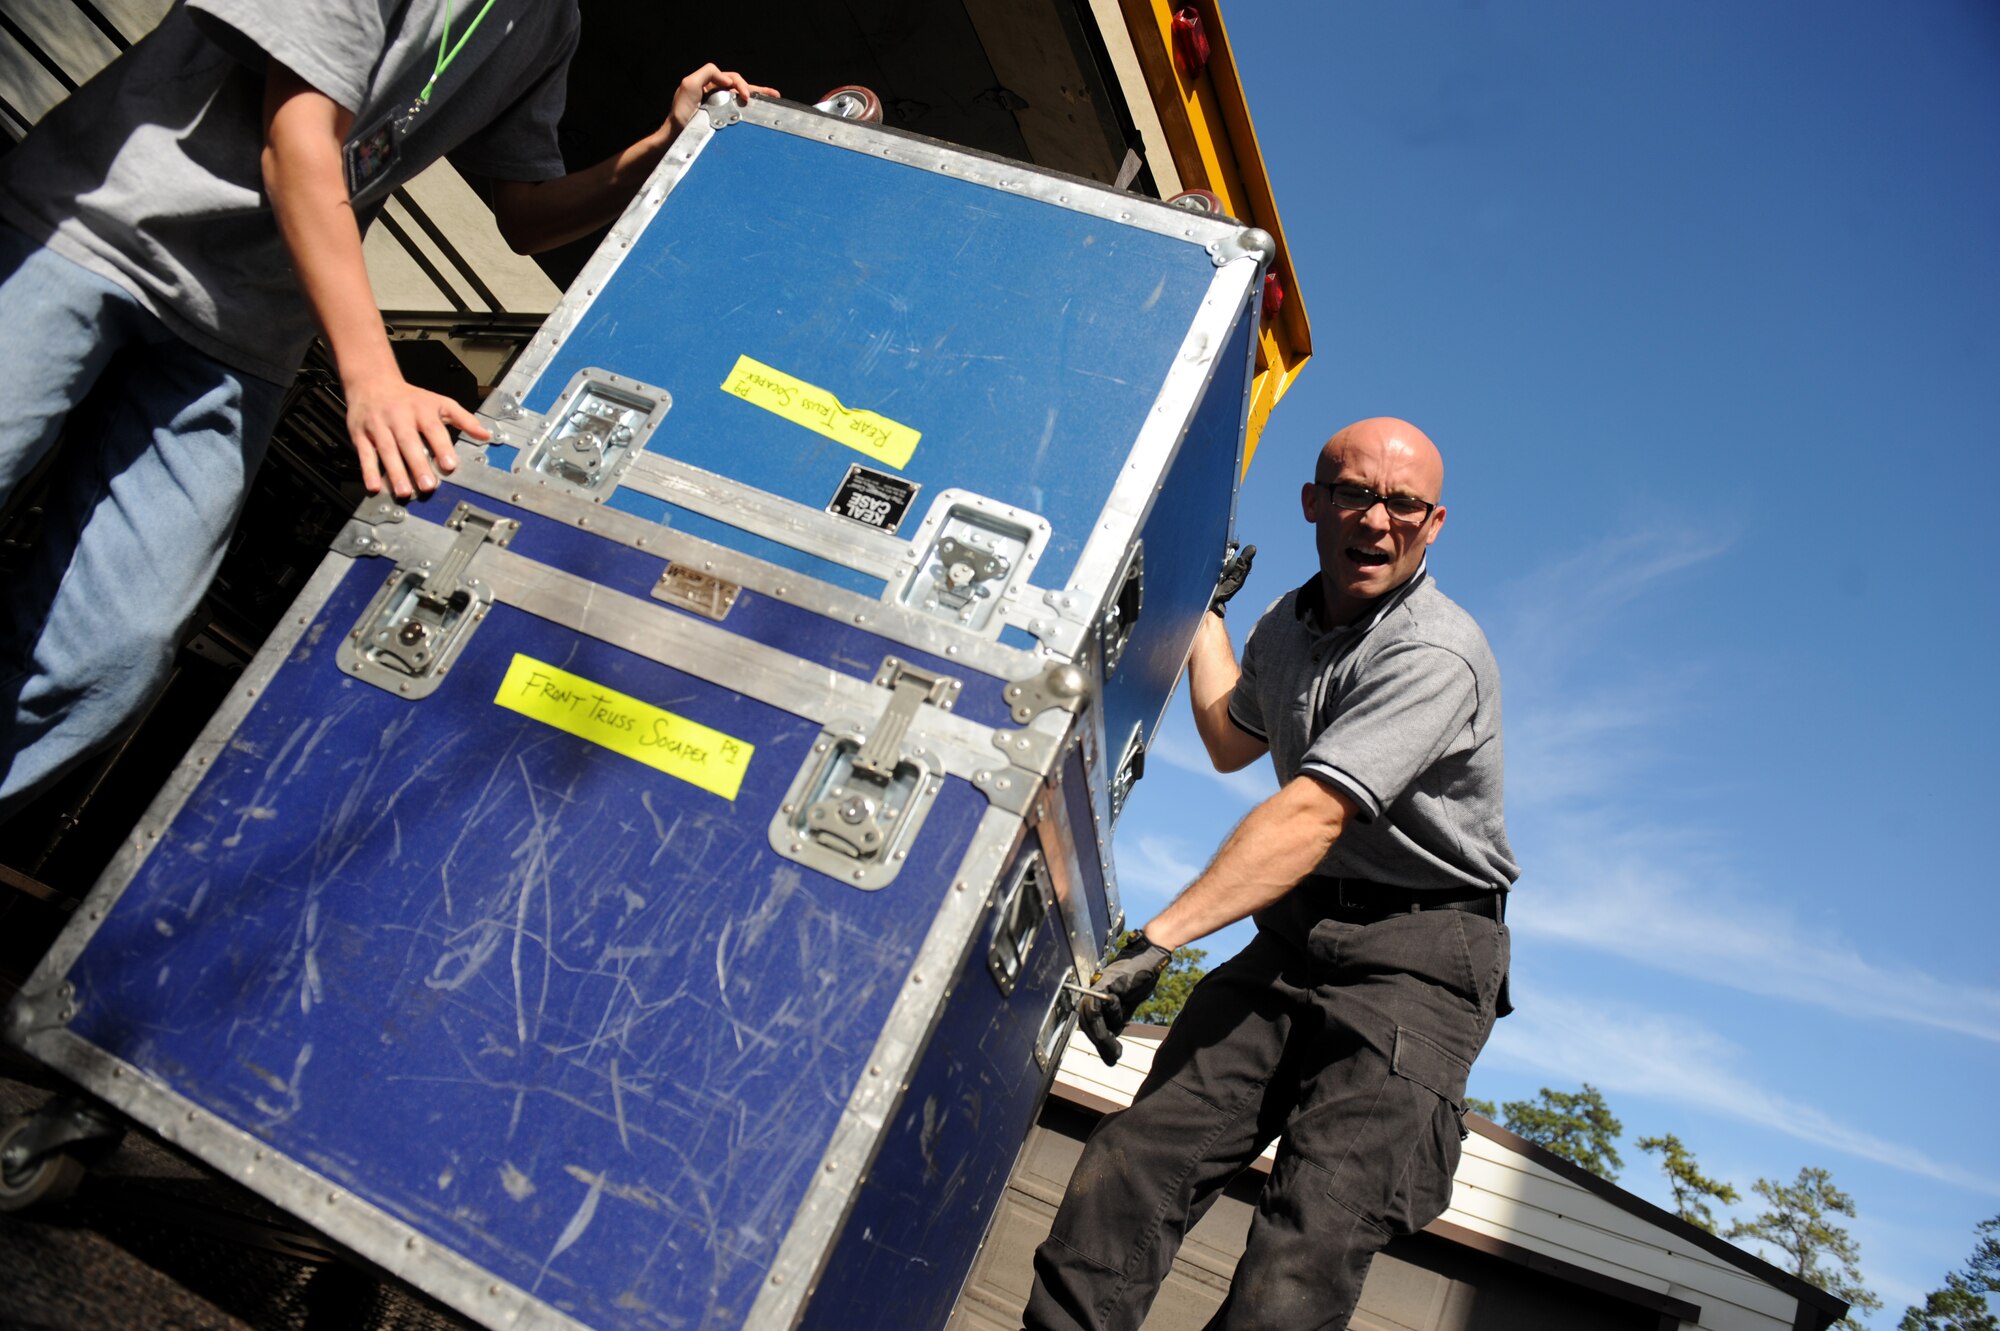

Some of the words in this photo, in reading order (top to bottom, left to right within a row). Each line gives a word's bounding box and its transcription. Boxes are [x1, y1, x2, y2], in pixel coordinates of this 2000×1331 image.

[800, 398, 837, 430] TRUSS
[849, 418, 893, 448] REAR
[846, 503, 886, 526] KEAL
[850, 491, 892, 515] CASE
[520, 672, 586, 711] FRONT
[588, 694, 637, 732] TRUSS
